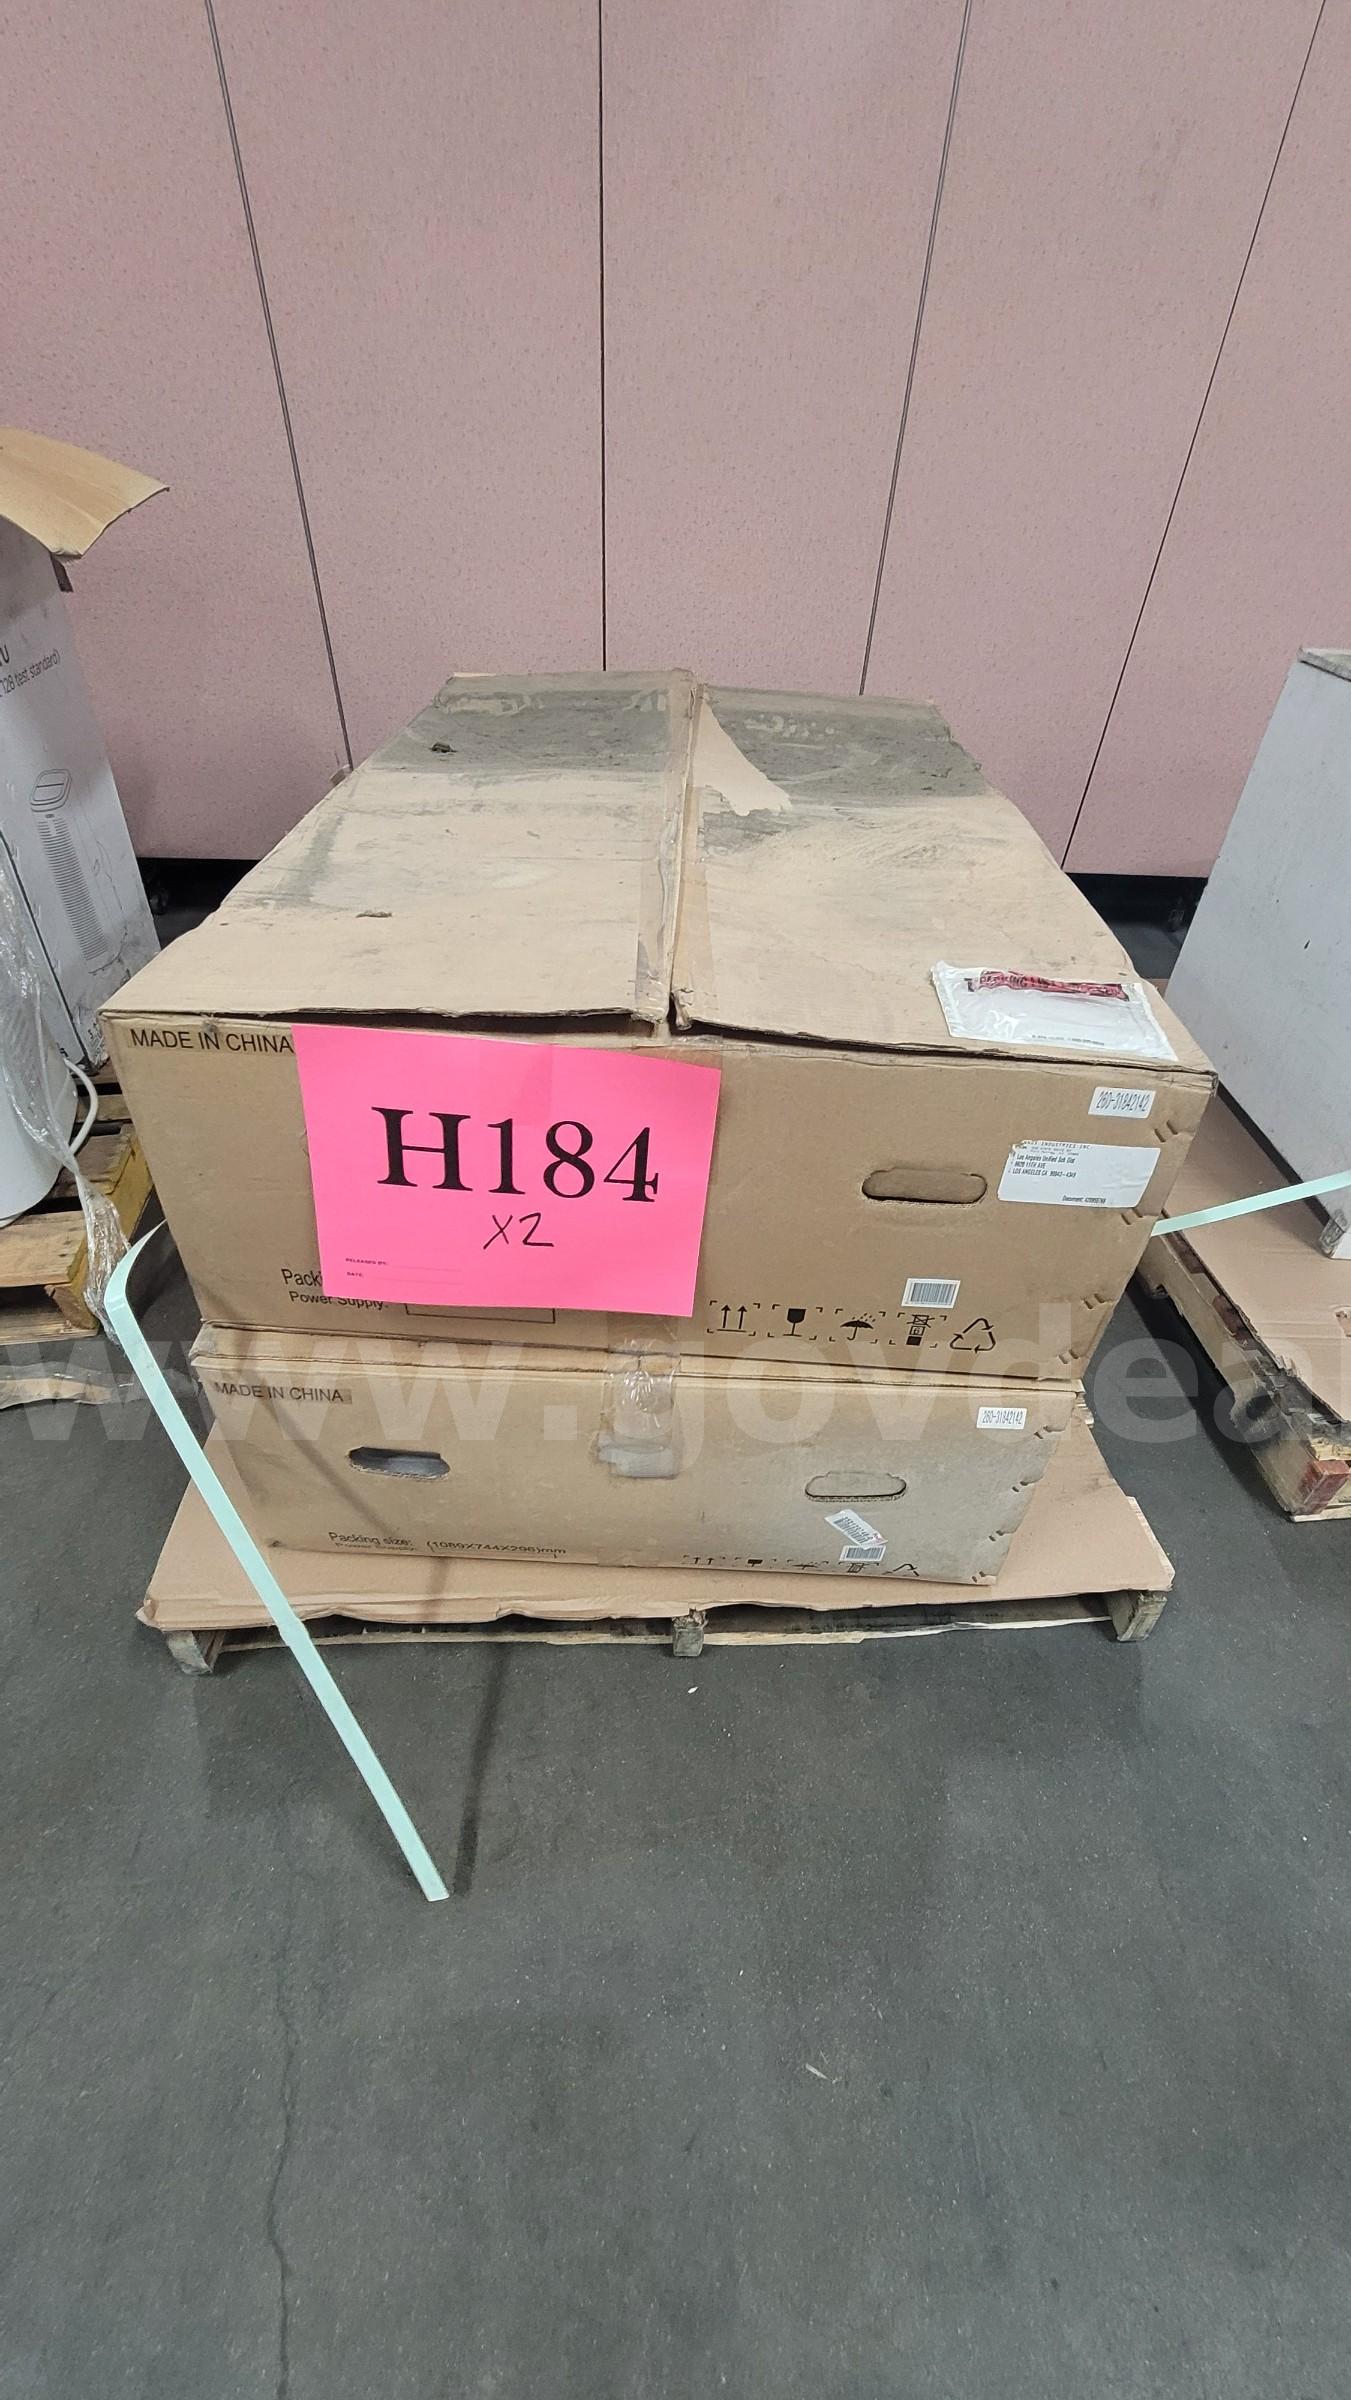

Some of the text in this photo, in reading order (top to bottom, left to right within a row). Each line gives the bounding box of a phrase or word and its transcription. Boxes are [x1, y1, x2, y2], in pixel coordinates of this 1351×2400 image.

[130, 1028, 194, 1049] MADE
[198, 1031, 221, 1051] IN
[225, 1033, 295, 1054] CHINA
[371, 1106, 660, 1202] H184
[289, 1290, 332, 1305] Power
[214, 1382, 344, 1402] MADE IN CHINA
[328, 1531, 381, 1545] Packing
